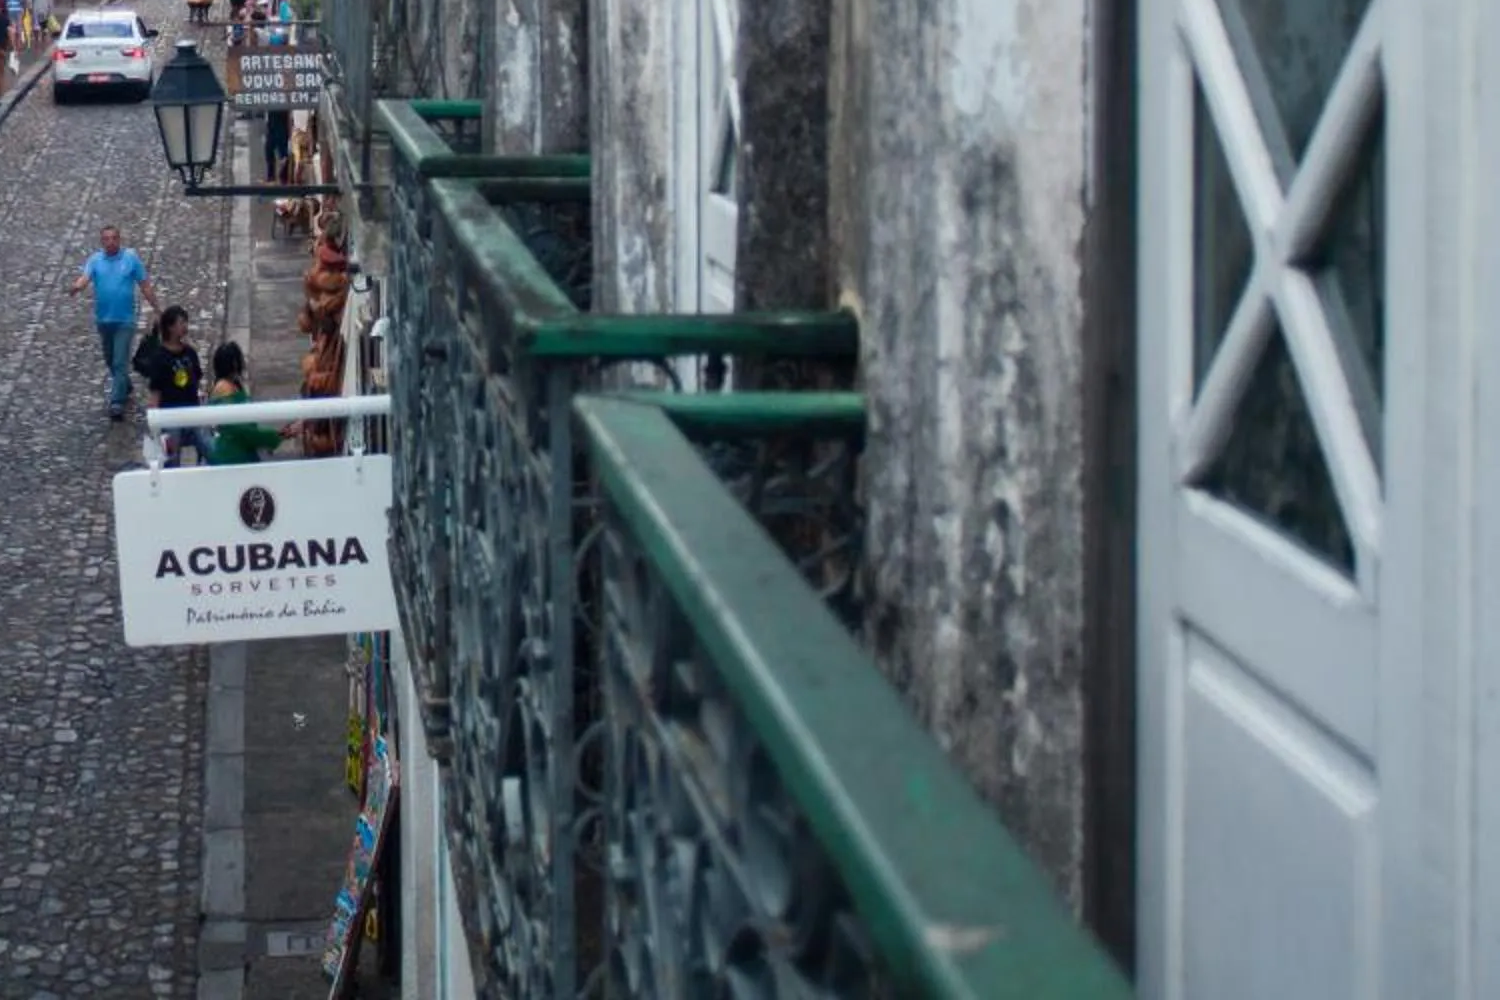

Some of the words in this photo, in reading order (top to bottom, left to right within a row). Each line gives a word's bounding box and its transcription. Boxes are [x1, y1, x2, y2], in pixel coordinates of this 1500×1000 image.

[191, 575, 337, 596] SORVETES
[277, 606, 298, 619] da
[303, 599, 347, 617] Bahia
